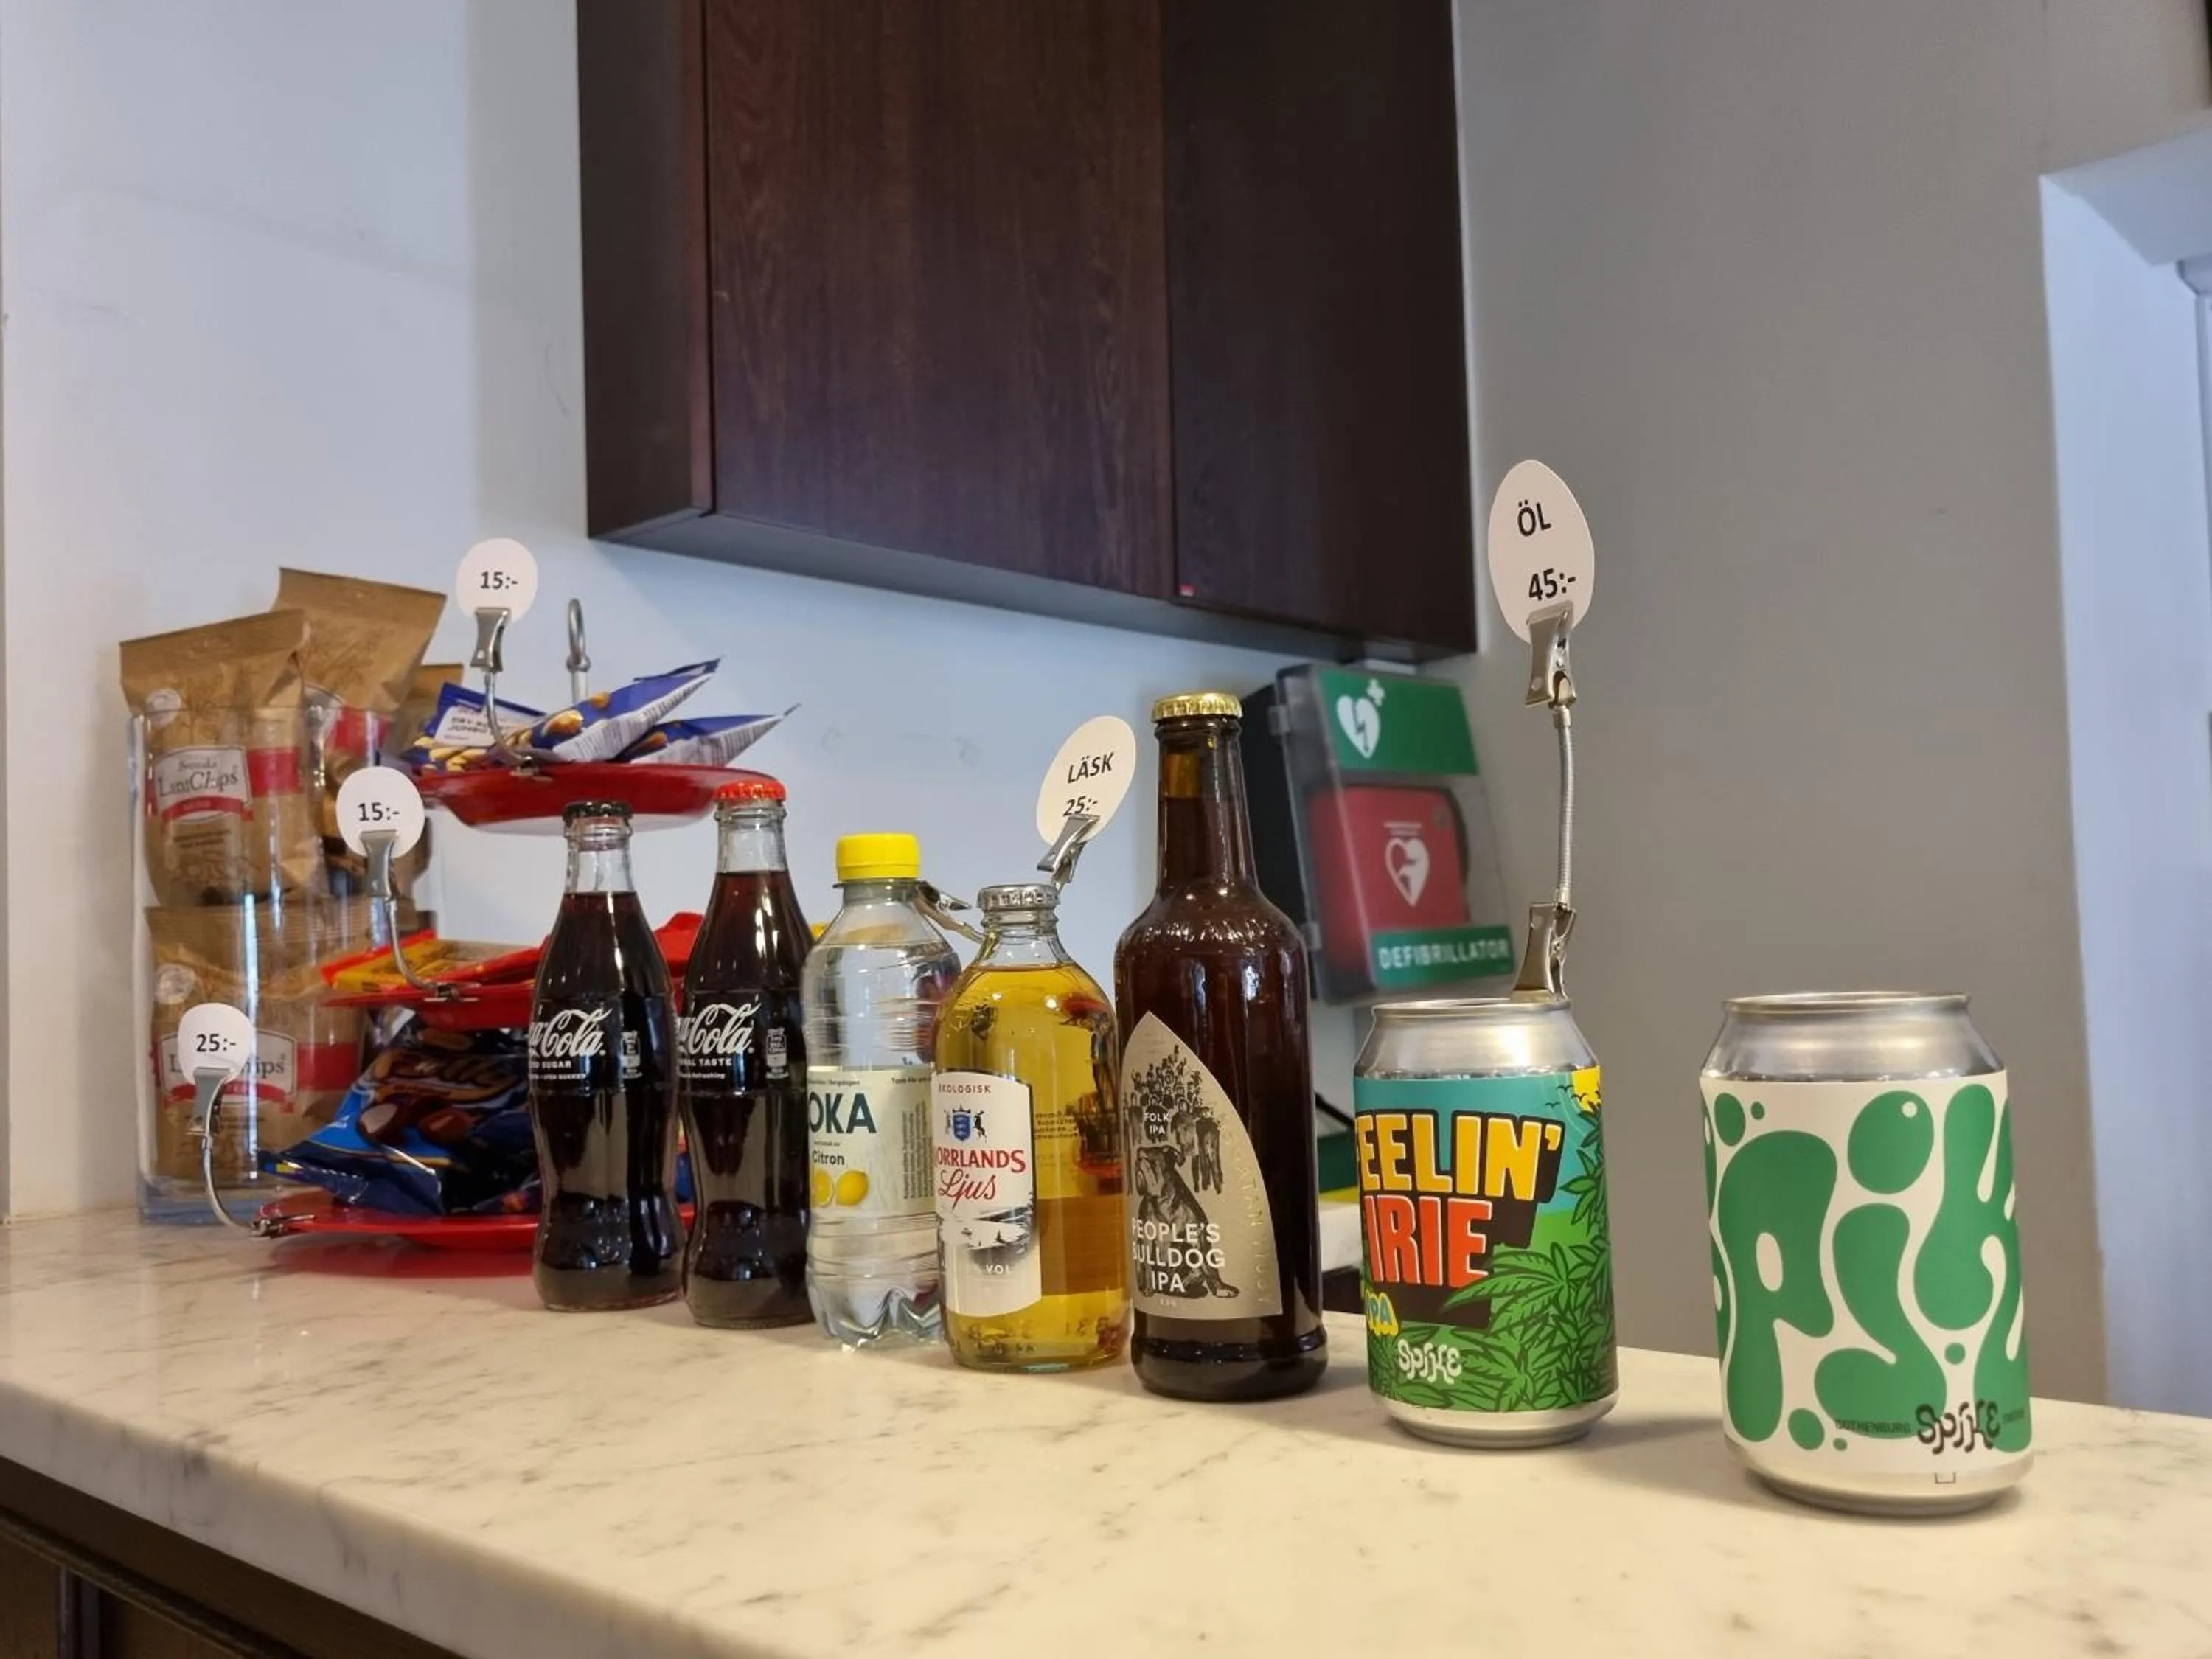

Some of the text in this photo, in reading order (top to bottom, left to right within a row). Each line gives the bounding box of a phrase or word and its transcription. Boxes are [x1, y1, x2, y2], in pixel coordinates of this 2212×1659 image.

[1517, 499, 1551, 536] ÖL
[480, 571, 518, 590] 15:-
[1528, 568, 1576, 601] 45:-
[1068, 752, 1113, 783] LÄSK
[358, 802, 400, 821] 15:-
[1063, 796, 1097, 816] 25:-
[1378, 937, 1510, 970] DEFIBRILLATOR
[196, 1033, 236, 1052] 25:-
[542, 1060, 571, 1068] SUGAR
[698, 1058, 732, 1066] TASTE
[810, 1091, 877, 1134] OKA
[1144, 1112, 1169, 1121] FOLK
[1150, 1124, 1166, 1135] IPA
[813, 1149, 845, 1166] Citron
[937, 1147, 1026, 1174] ORRLANDS
[1357, 1113, 1562, 1200] EELIN'
[938, 1168, 997, 1210] Ljus
[1132, 1217, 1221, 1243] PEOPLE'S
[1363, 1194, 1493, 1289] IRIE
[1132, 1239, 1225, 1268] BULLDOG
[1151, 1270, 1186, 1293] IPA
[1366, 1291, 1398, 1336] PA
